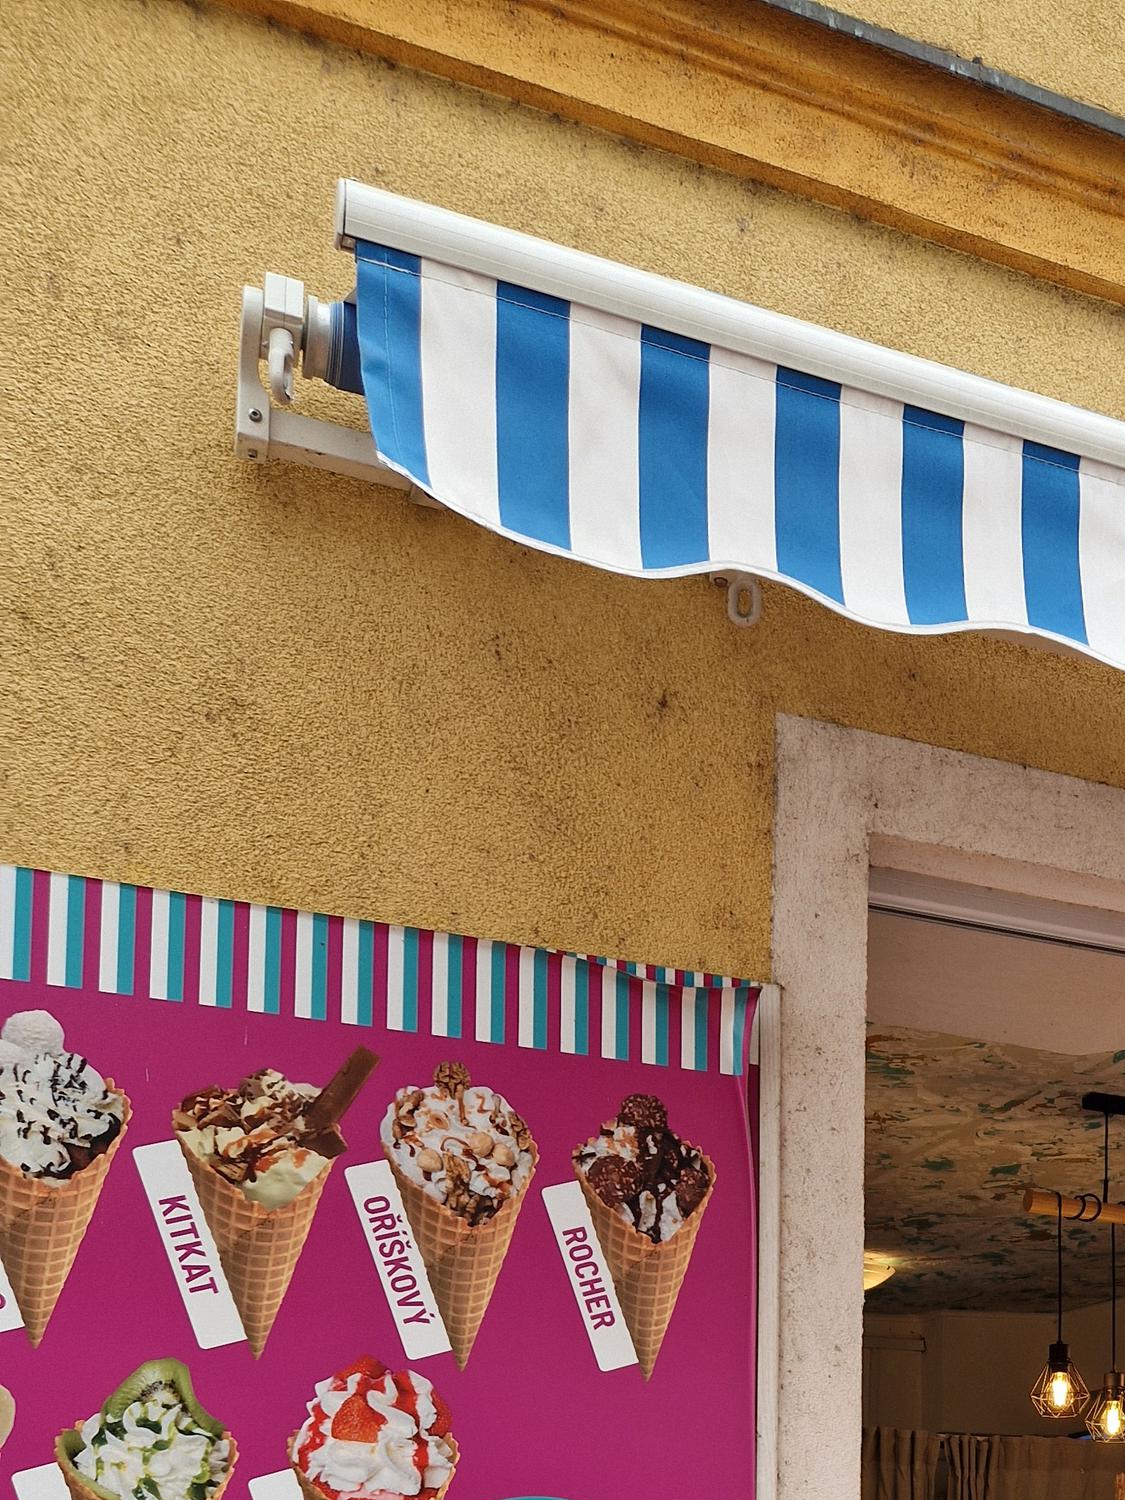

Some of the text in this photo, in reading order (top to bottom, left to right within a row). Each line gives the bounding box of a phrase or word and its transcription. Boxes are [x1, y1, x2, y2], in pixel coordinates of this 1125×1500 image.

[158, 1195, 218, 1294] KITKAT
[363, 1195, 435, 1325] OŘÍŠKOVÝ
[561, 1226, 616, 1330] ROCHER
